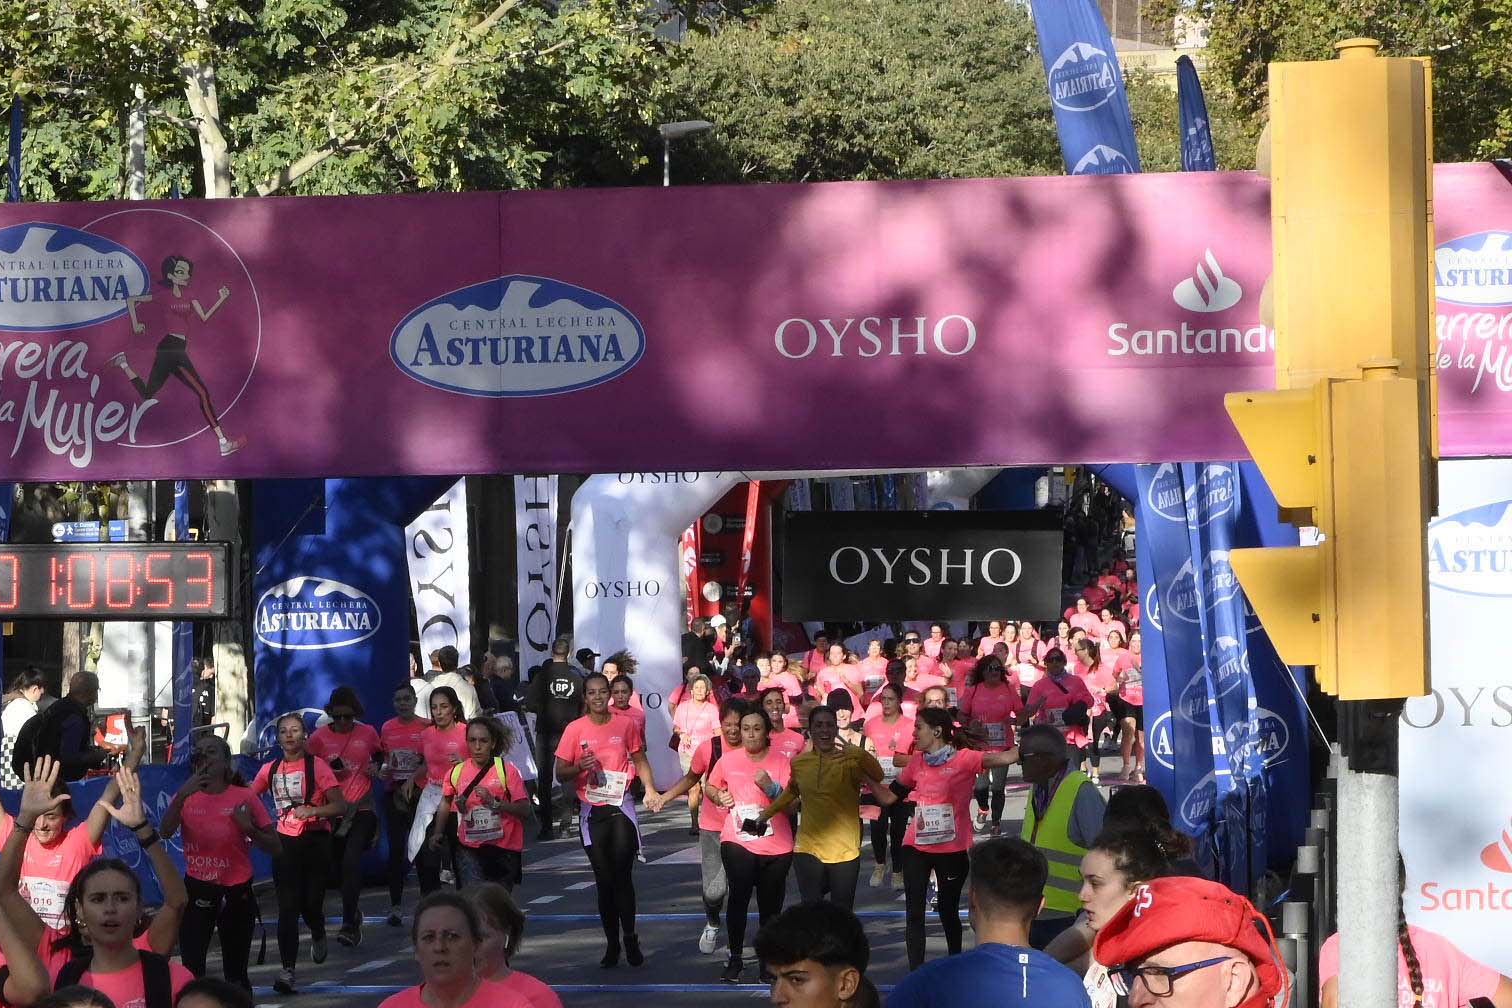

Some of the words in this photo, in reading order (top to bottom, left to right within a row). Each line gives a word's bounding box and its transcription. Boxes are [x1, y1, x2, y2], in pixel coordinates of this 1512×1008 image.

[51, 257, 125, 272] LECHERA
[449, 317, 529, 332] CENTRAL
[534, 314, 618, 330] LECHERA
[774, 314, 977, 359] OYSHO
[409, 322, 626, 368] ASTURIANA
[10, 373, 159, 469] Mujer
[829, 546, 1022, 587] OYSHO
[272, 600, 314, 610] CENTRAL
[319, 598, 368, 609] LECHERA
[585, 580, 660, 599] OYSHO
[259, 604, 372, 634] ASTURIANA
